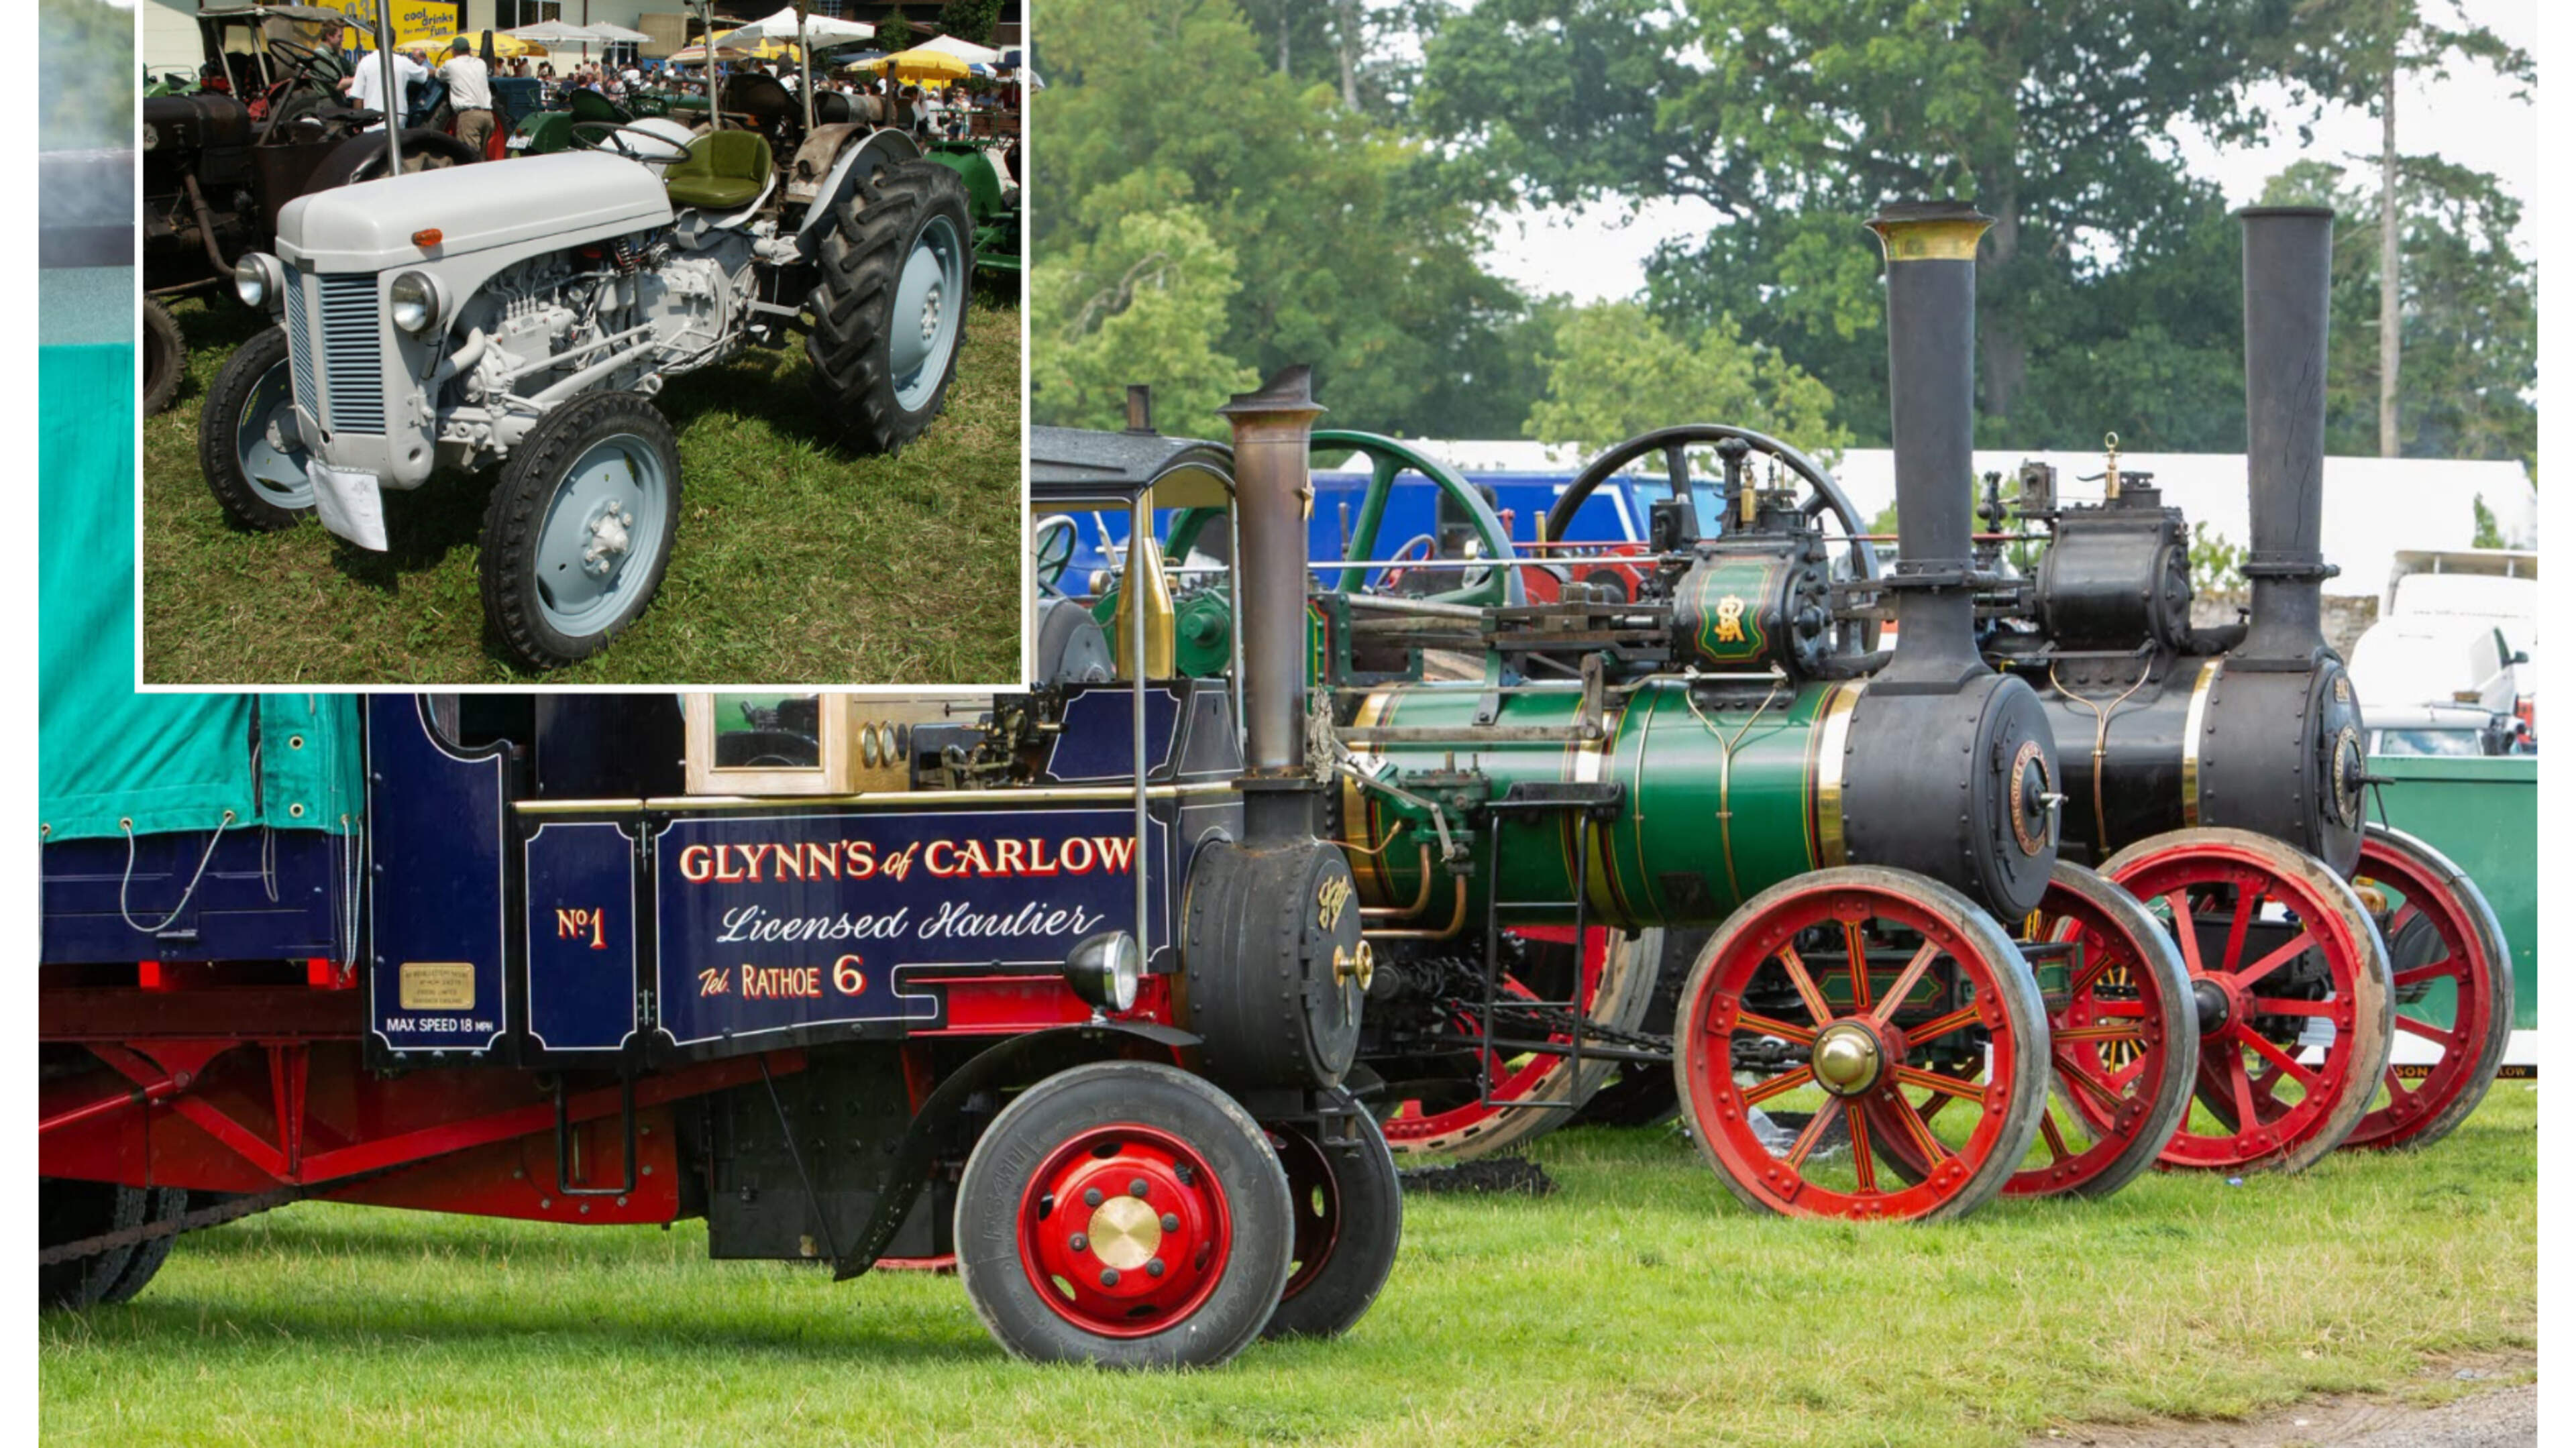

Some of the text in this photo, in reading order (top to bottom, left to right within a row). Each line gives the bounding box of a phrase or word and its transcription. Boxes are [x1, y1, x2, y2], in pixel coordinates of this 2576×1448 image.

[404, 7, 426, 21] cool
[422, 13, 454, 26] drinks
[680, 836, 1136, 883] GLYNN'S of CARLOW
[716, 901, 1105, 942] Licensed Haulier
[698, 954, 867, 1000] Tel. RATHOE 6
[387, 1018, 493, 1032] MAX SPEED 18 MPH
